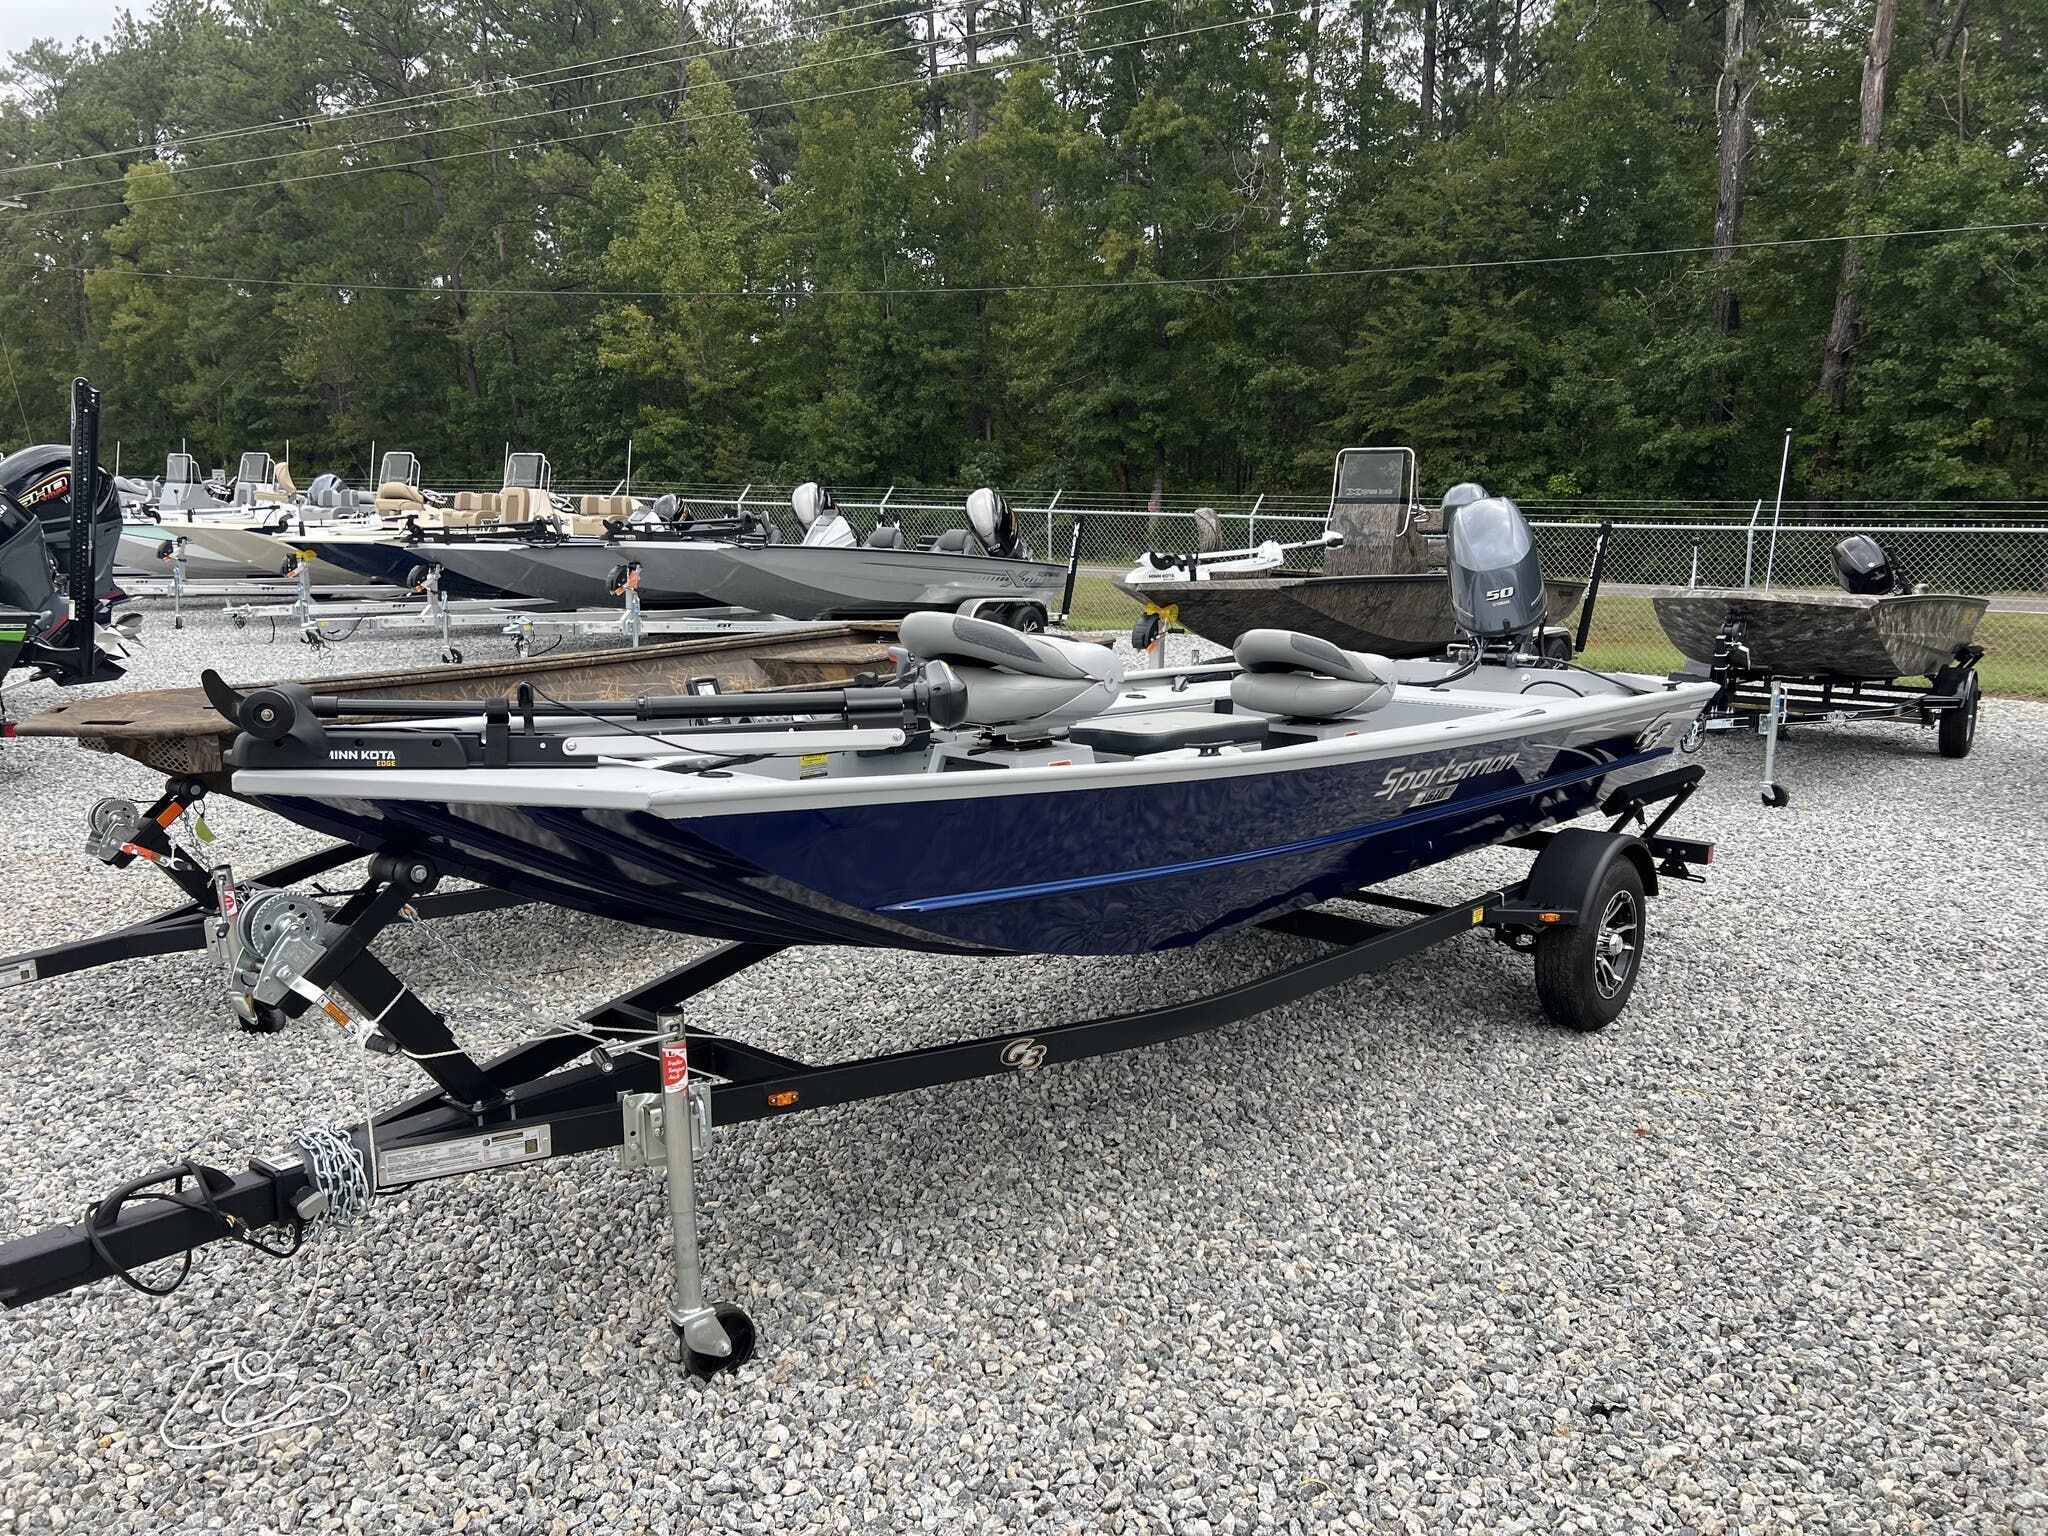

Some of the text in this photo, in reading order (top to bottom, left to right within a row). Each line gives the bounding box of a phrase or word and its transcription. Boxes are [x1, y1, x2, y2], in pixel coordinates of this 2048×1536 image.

[1486, 586, 1515, 601] 50
[360, 750, 396, 760] KOTA
[1374, 752, 1520, 801] Sportsman
[1000, 1038, 1047, 1070] G3
